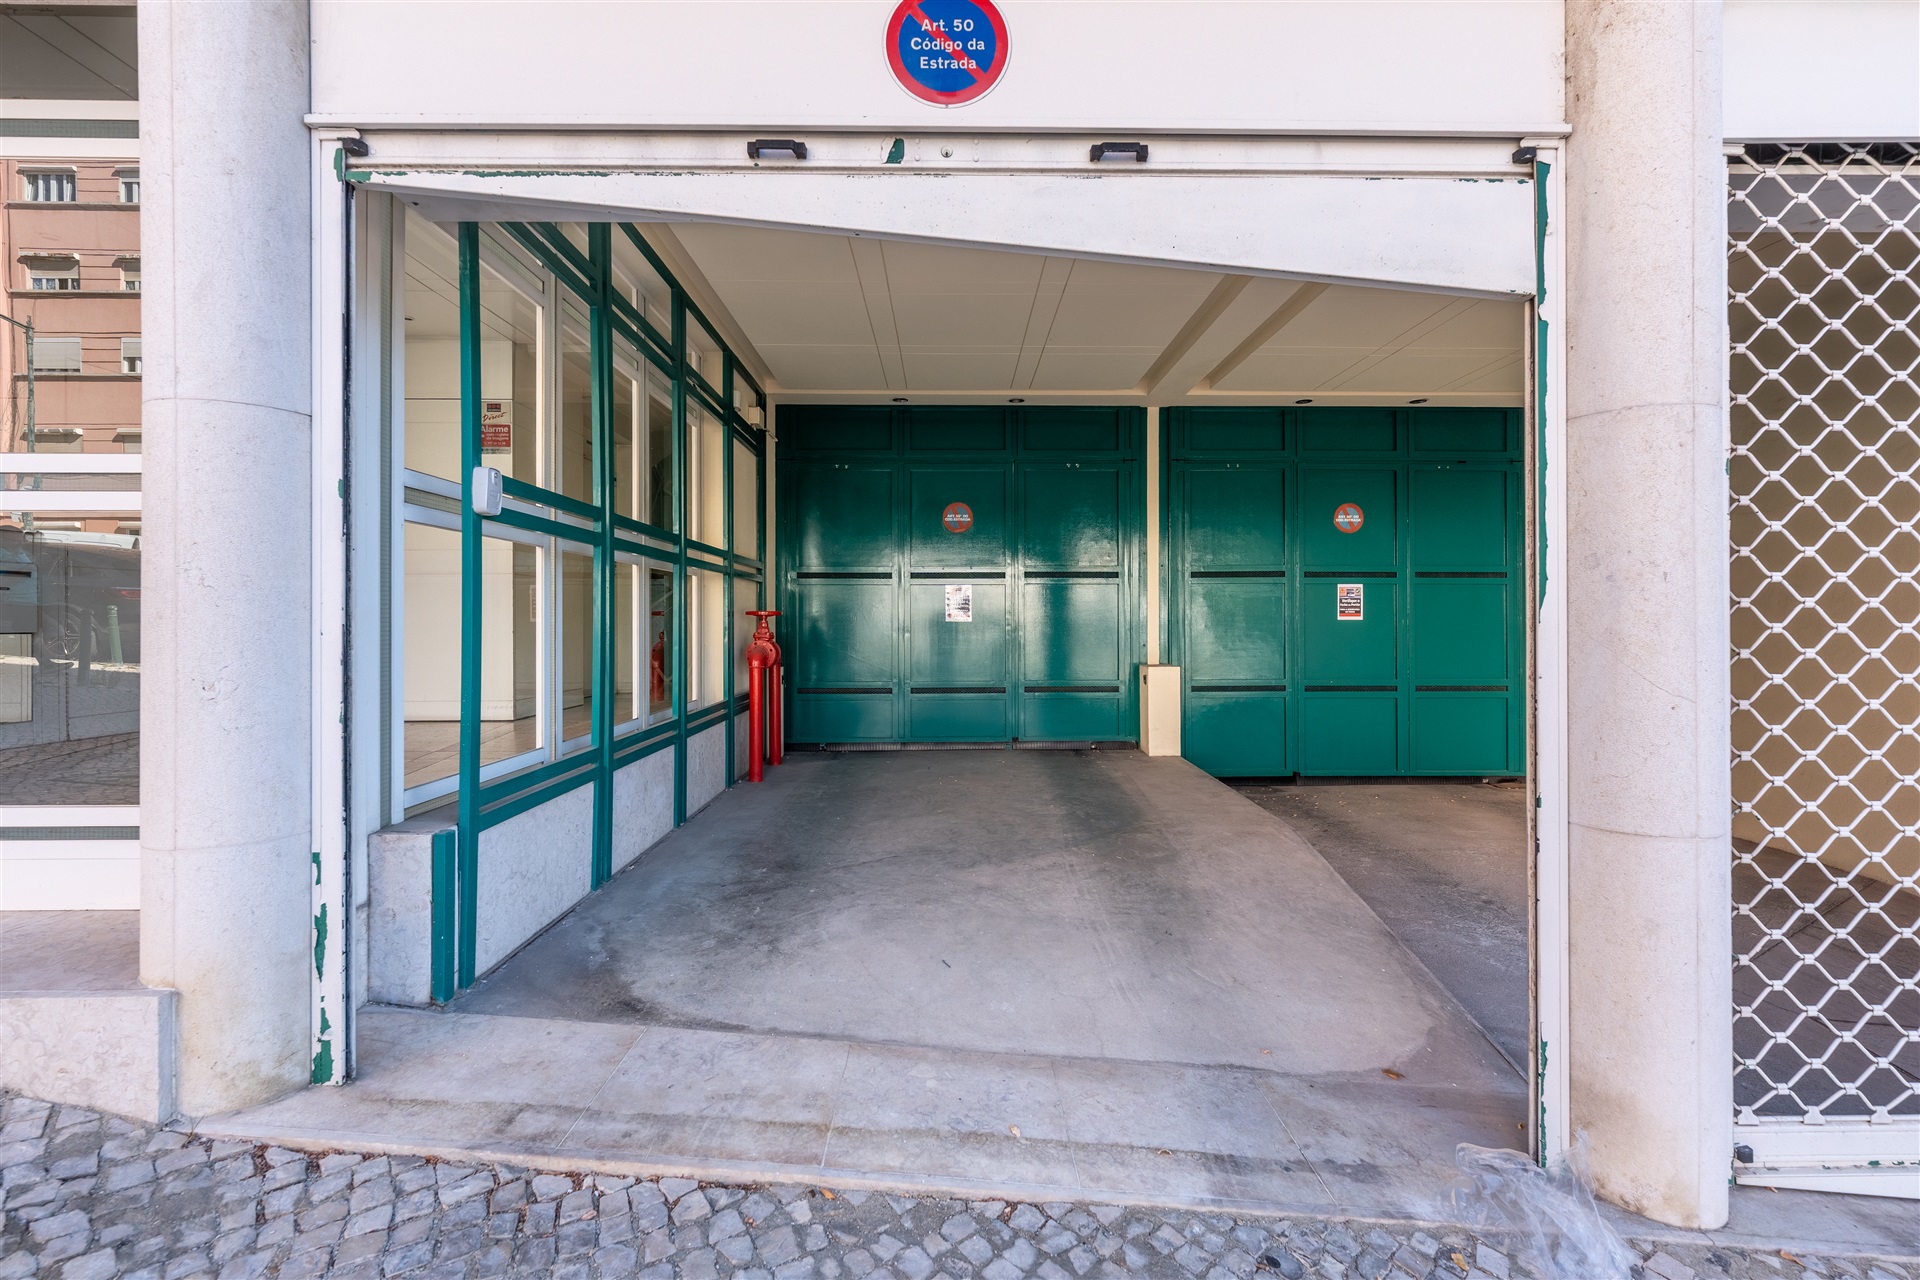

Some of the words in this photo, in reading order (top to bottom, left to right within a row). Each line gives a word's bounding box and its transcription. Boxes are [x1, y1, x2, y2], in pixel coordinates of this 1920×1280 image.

[921, 19, 949, 32] Art.
[953, 19, 974, 32] 50
[910, 37, 963, 53] Código
[967, 38, 985, 51] da
[920, 56, 977, 69] Estrada
[481, 425, 509, 433] Alarme
